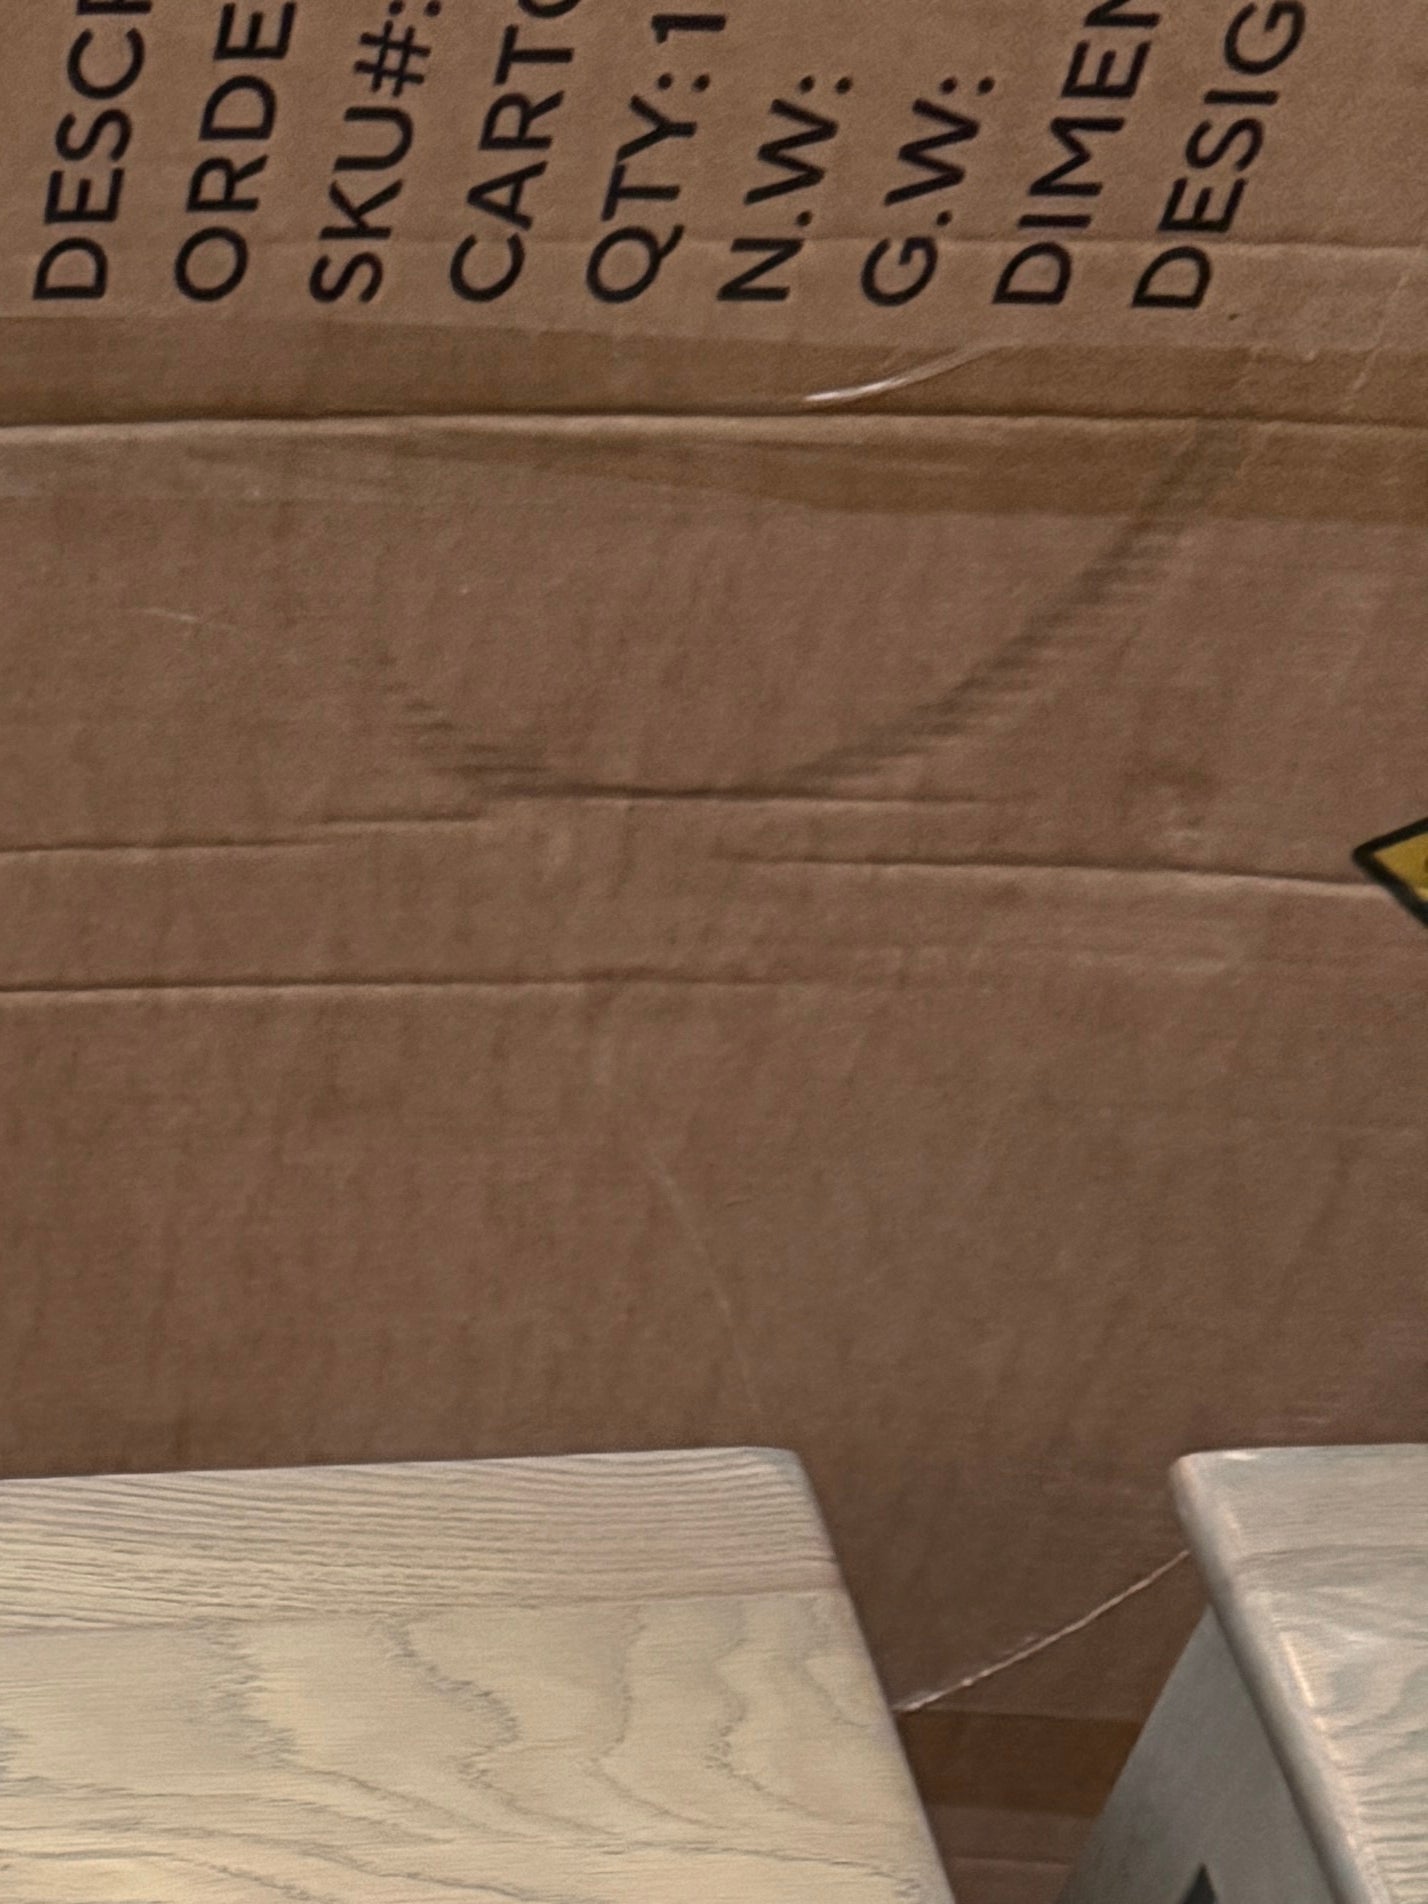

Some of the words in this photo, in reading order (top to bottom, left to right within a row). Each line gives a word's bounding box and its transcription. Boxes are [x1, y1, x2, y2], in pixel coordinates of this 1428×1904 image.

[32, 0, 153, 301] DESC
[449, 0, 581, 303] CART
[1130, 0, 1306, 310] DESIG
